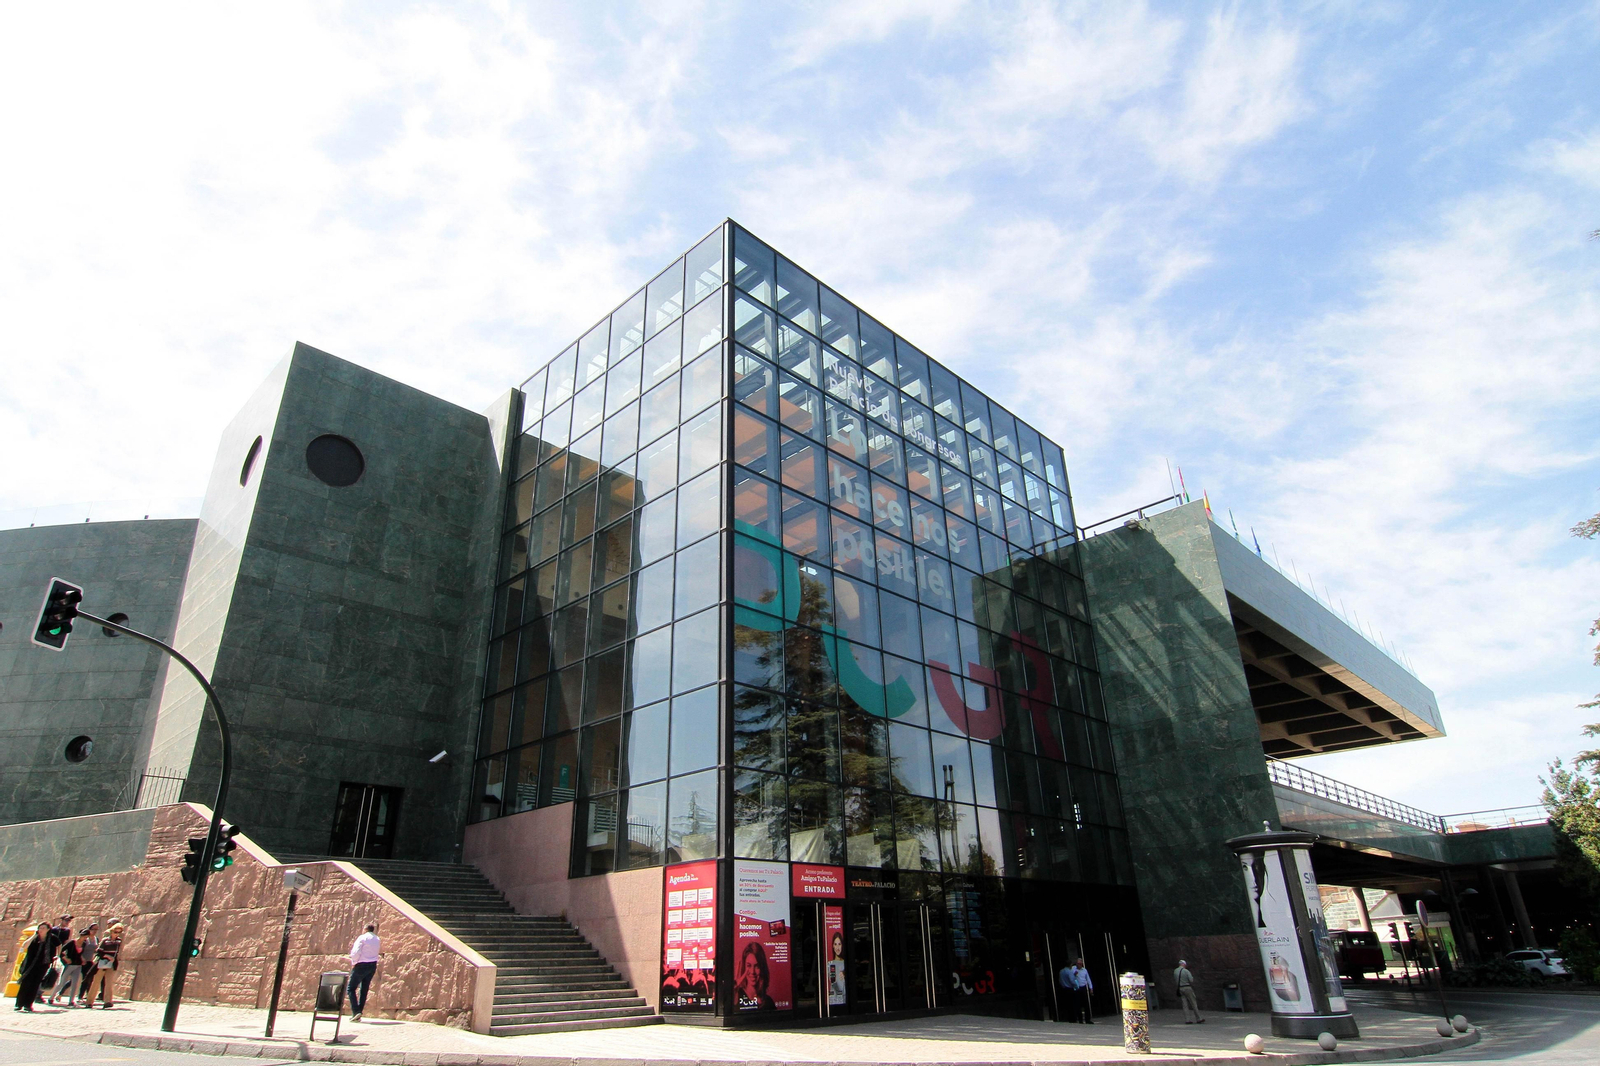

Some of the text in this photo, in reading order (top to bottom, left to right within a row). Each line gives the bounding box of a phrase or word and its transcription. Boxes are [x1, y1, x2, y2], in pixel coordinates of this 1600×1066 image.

[828, 358, 873, 394] Nuevo
[830, 407, 868, 458] Lo
[882, 409, 898, 428] de
[833, 462, 961, 554] hacemos
[836, 527, 952, 600] posible.
[669, 872, 690, 886] Agenda
[804, 885, 835, 894] ENTRADA
